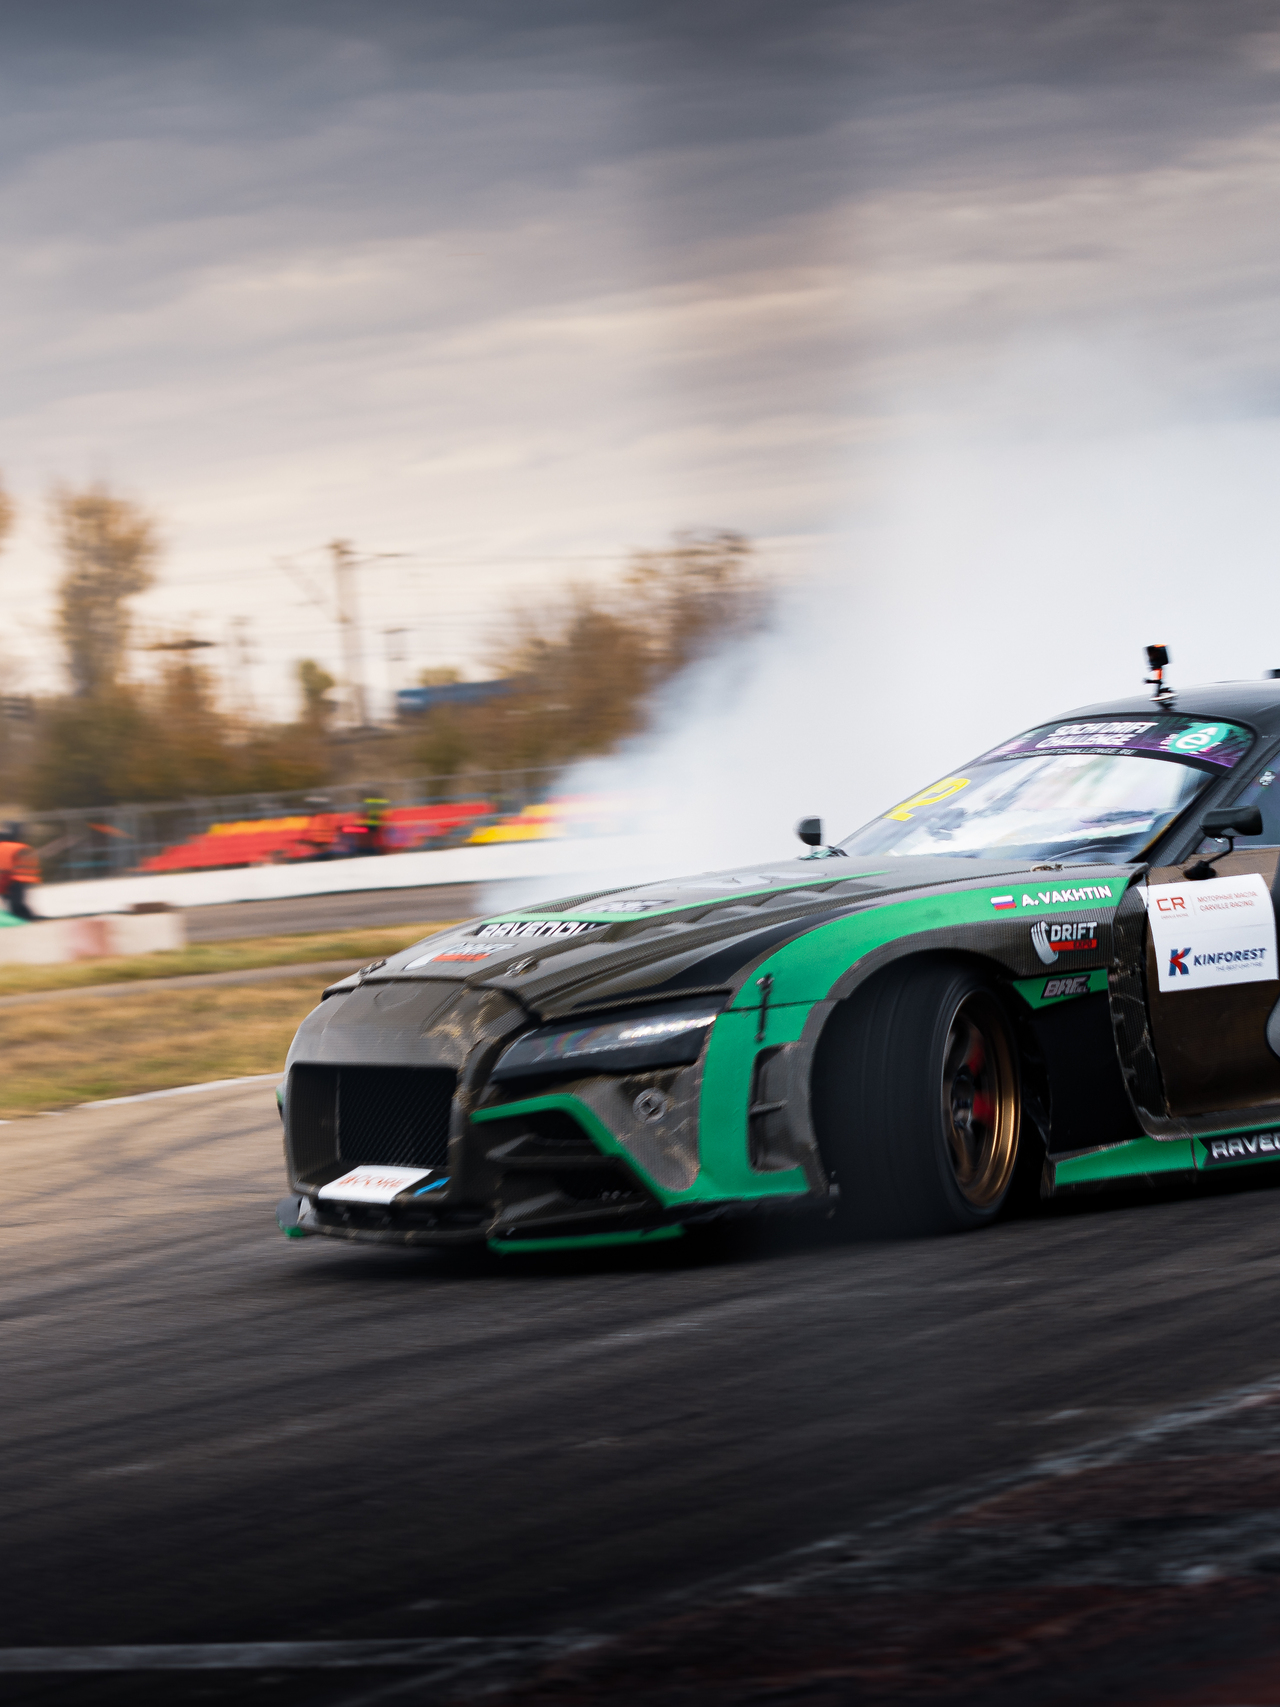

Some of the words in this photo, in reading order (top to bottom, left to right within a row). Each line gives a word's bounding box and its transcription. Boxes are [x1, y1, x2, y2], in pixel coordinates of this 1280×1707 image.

[1156, 896, 1186, 911] CR
[1050, 921, 1098, 942] DRIFT
[1193, 947, 1266, 967] KINFOREST
